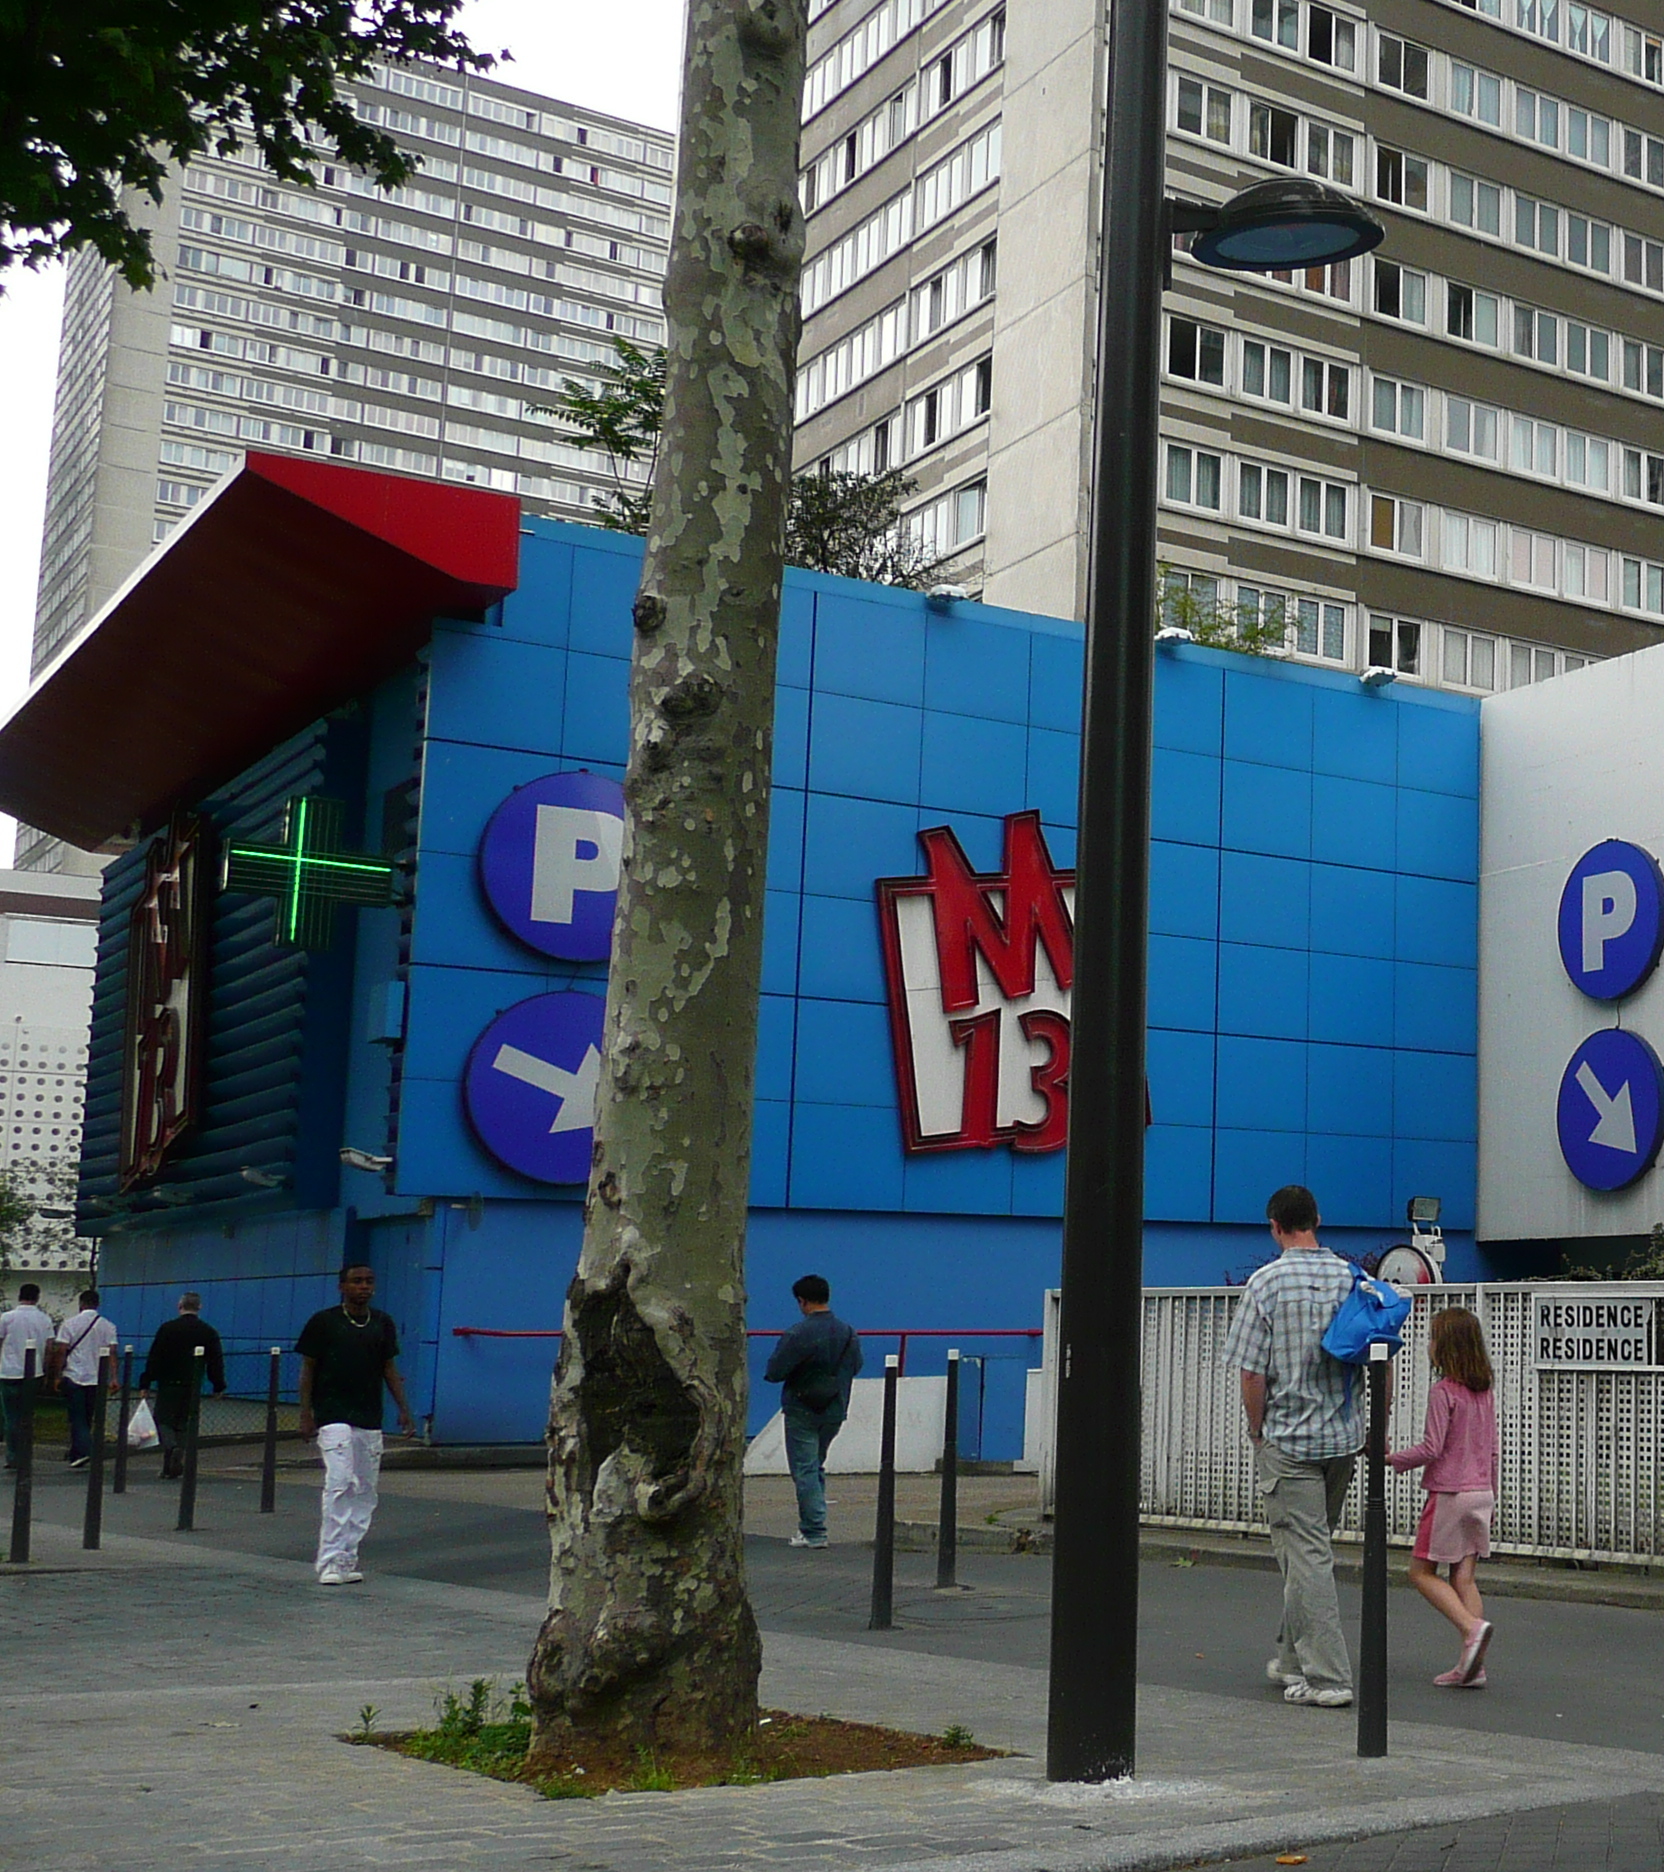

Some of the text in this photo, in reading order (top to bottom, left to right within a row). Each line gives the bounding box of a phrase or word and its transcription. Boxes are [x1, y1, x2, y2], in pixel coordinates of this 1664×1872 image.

[531, 803, 624, 925] P
[1582, 870, 1637, 973] P
[1540, 1305, 1644, 1329] RESIDENCE
[1540, 1337, 1644, 1361] RESIDENCE
